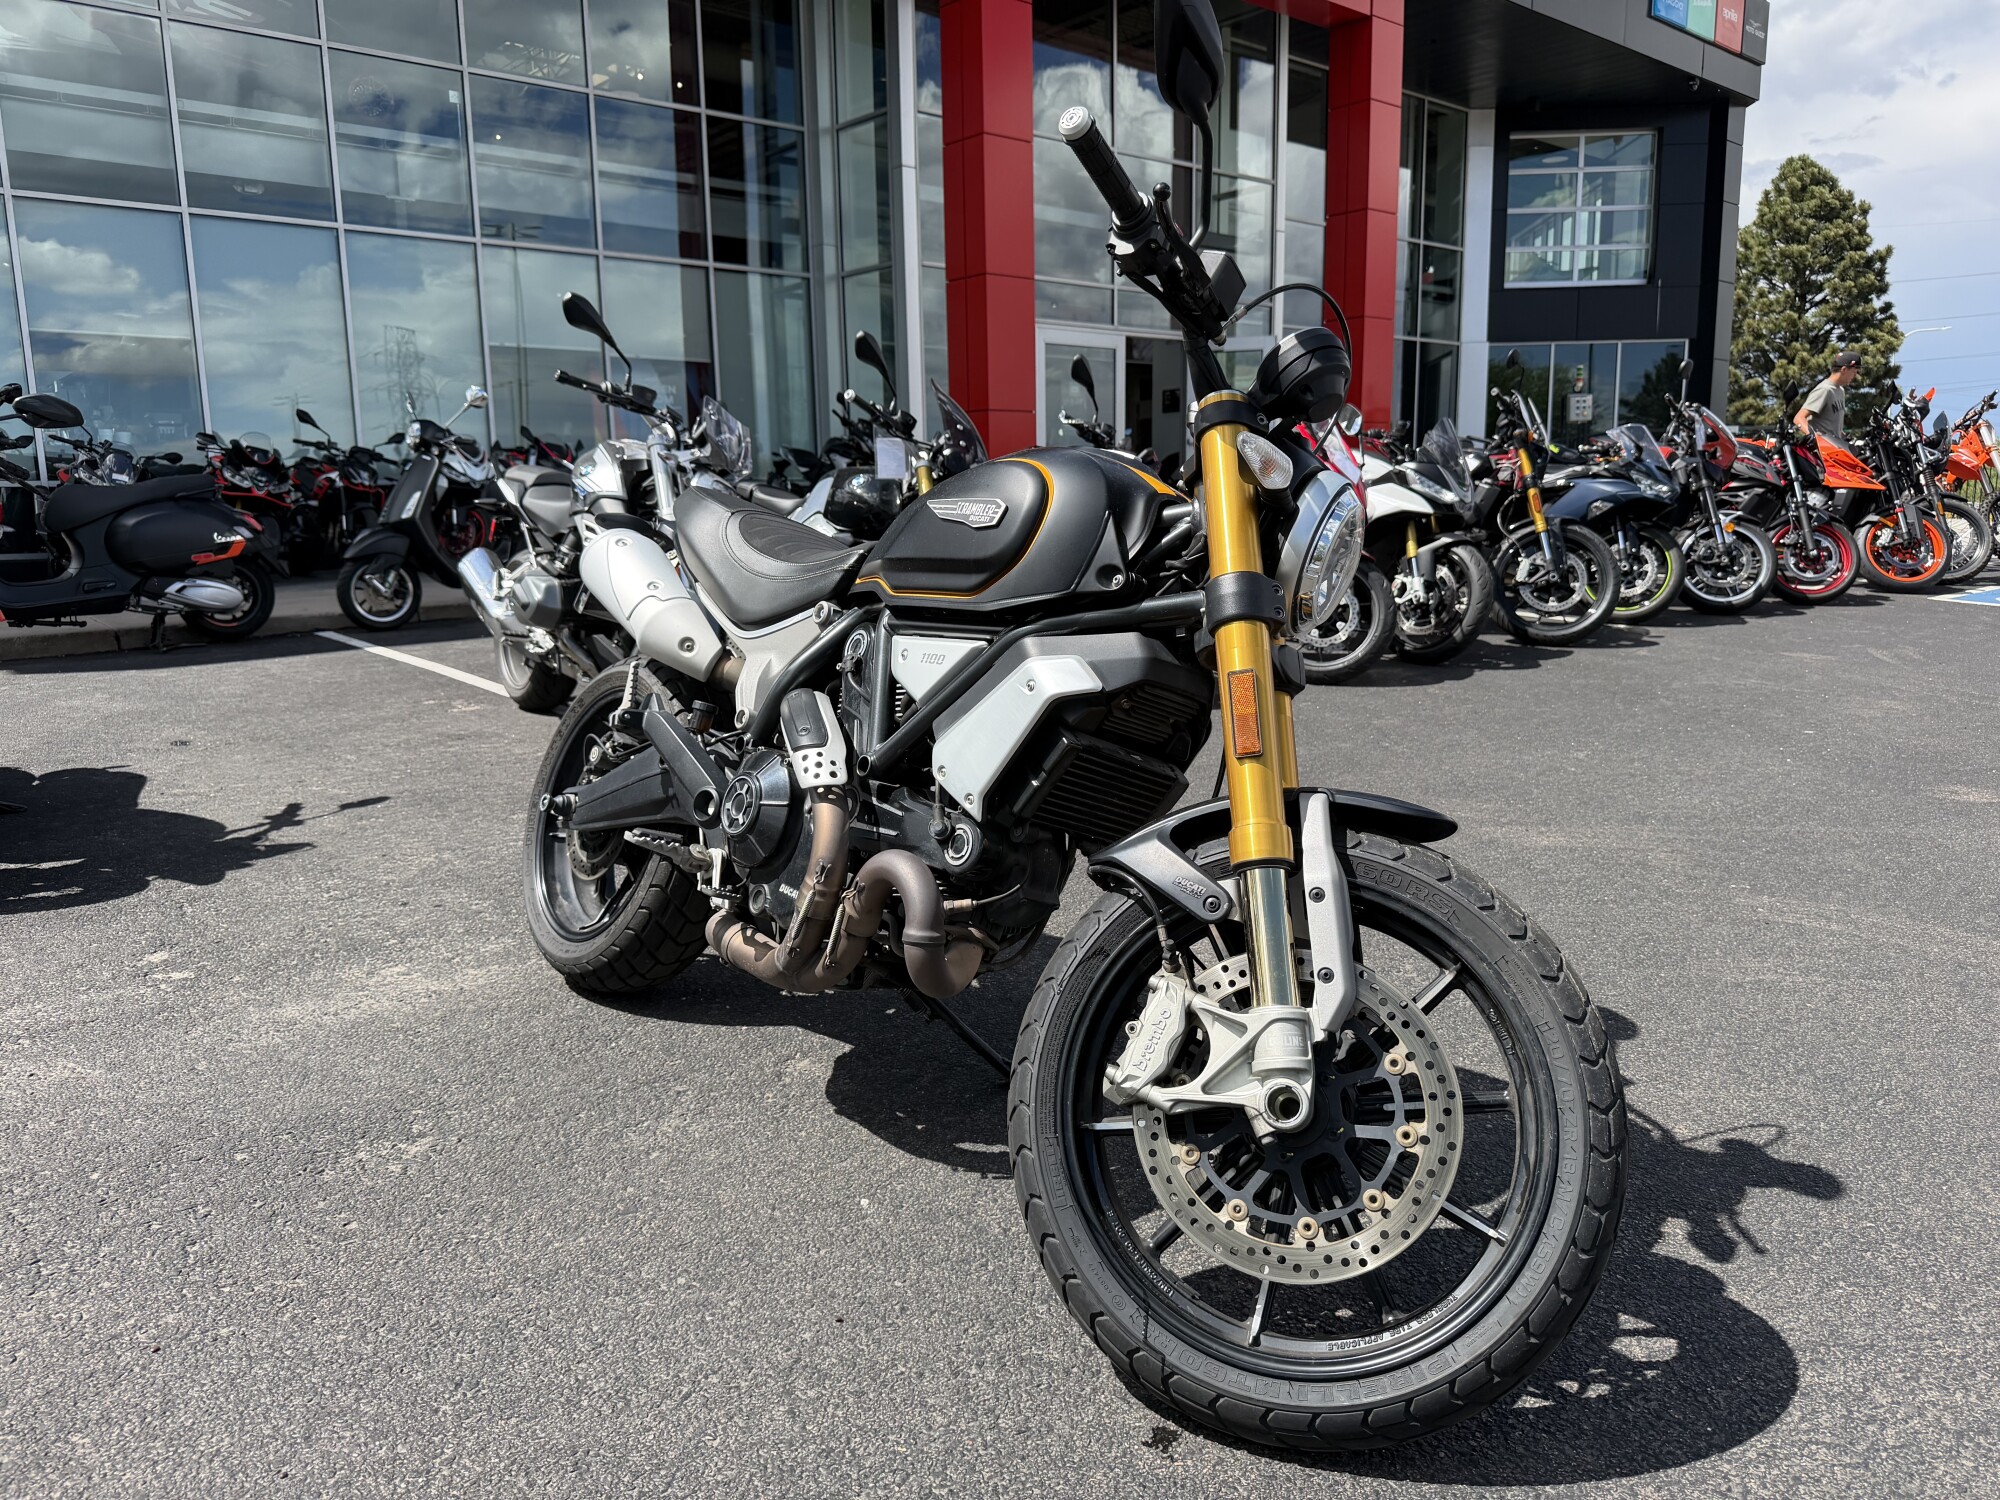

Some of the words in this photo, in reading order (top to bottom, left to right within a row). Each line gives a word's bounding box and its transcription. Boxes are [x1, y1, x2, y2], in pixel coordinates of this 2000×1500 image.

[955, 502, 995, 516] SCRAMBLER
[920, 652, 947, 665] 1100
[1174, 876, 1207, 894] DUCATI
[1133, 1008, 1172, 1072] brembo
[1327, 1333, 1385, 1351] APPLICABLE
[1178, 1349, 1282, 1399] MT60
[1298, 1352, 1453, 1401] PIRELLI
